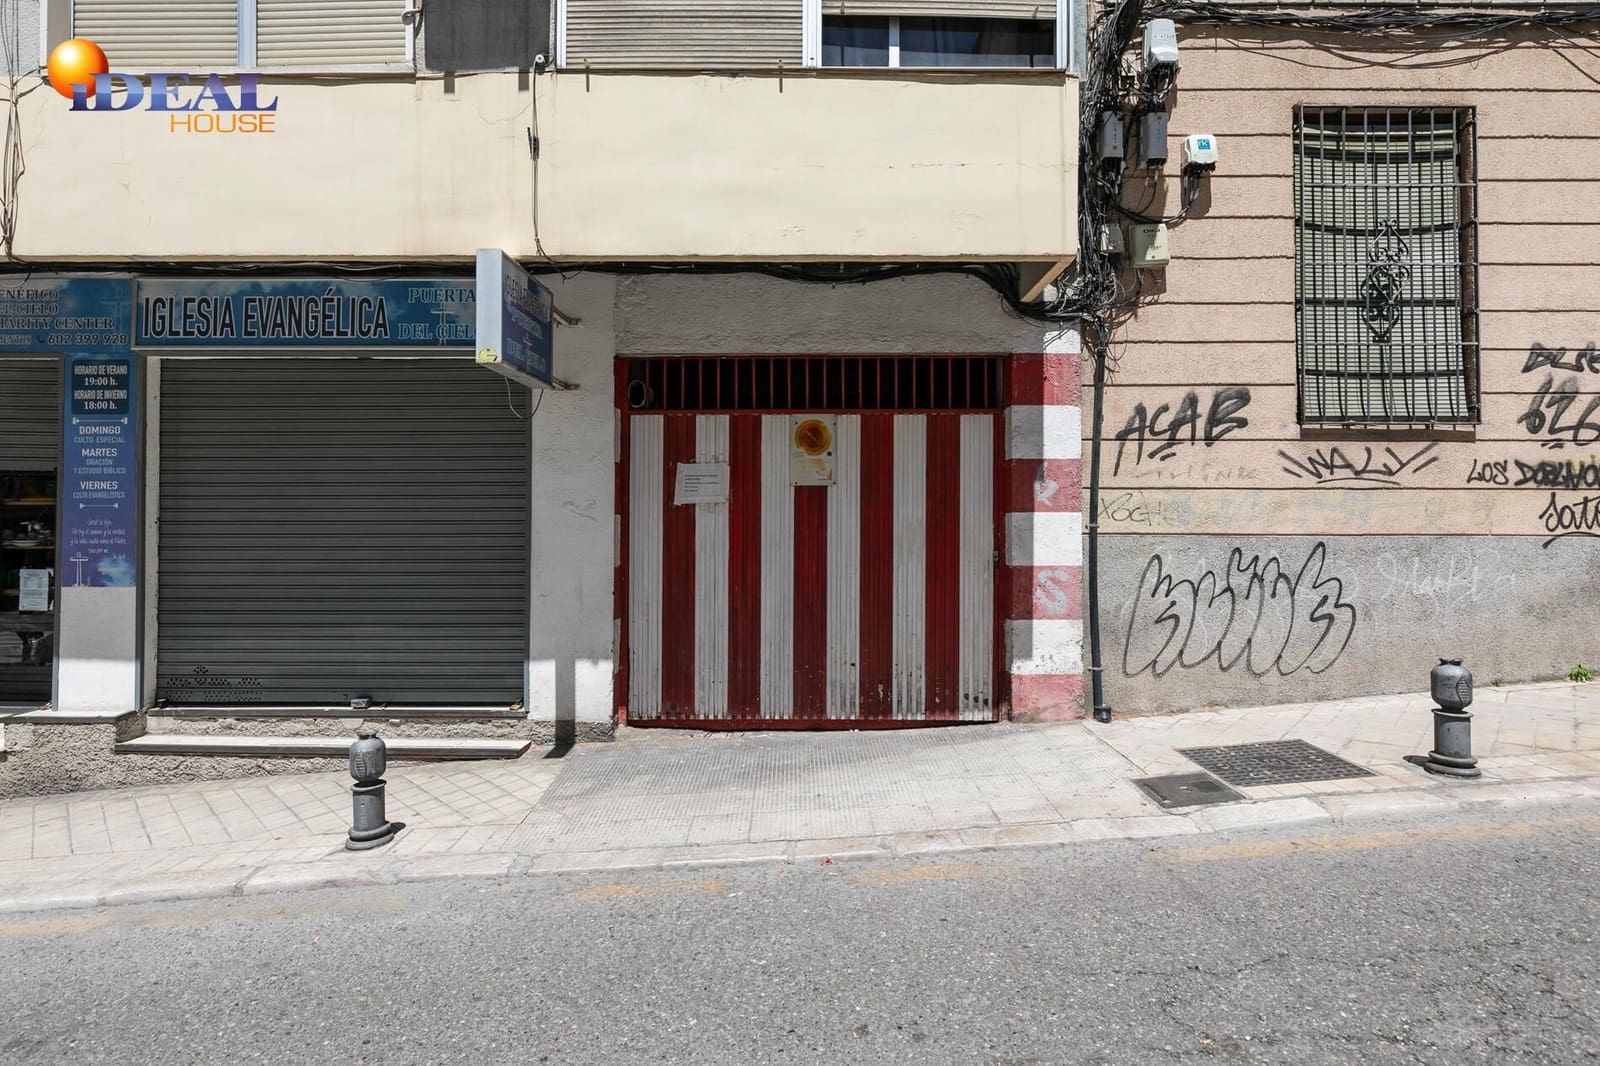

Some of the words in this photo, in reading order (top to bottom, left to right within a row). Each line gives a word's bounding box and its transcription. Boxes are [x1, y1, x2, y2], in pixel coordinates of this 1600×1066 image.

[408, 287, 476, 304] PUERTA
[143, 295, 236, 339] IGLESIA
[242, 287, 390, 339] EVANGÉLICA
[54, 317, 114, 330] CENTER
[398, 323, 433, 340] DEL
[436, 323, 476, 340] CIEL
[48, 334, 72, 345] 602
[75, 334, 99, 345] 399
[103, 334, 128, 345] 928
[74, 365, 98, 375] HORARIO
[98, 365, 106, 375] DE
[106, 365, 128, 375] VERANO
[84, 377, 108, 386] 19:00
[109, 377, 118, 386] h.
[96, 390, 104, 400] DE
[84, 401, 108, 410] 18:00
[109, 401, 117, 410] h.
[79, 426, 121, 435] DOMINGO
[81, 448, 118, 457] MARTES
[1467, 459, 1510, 485] LOS
[80, 481, 118, 490] VIERNES
